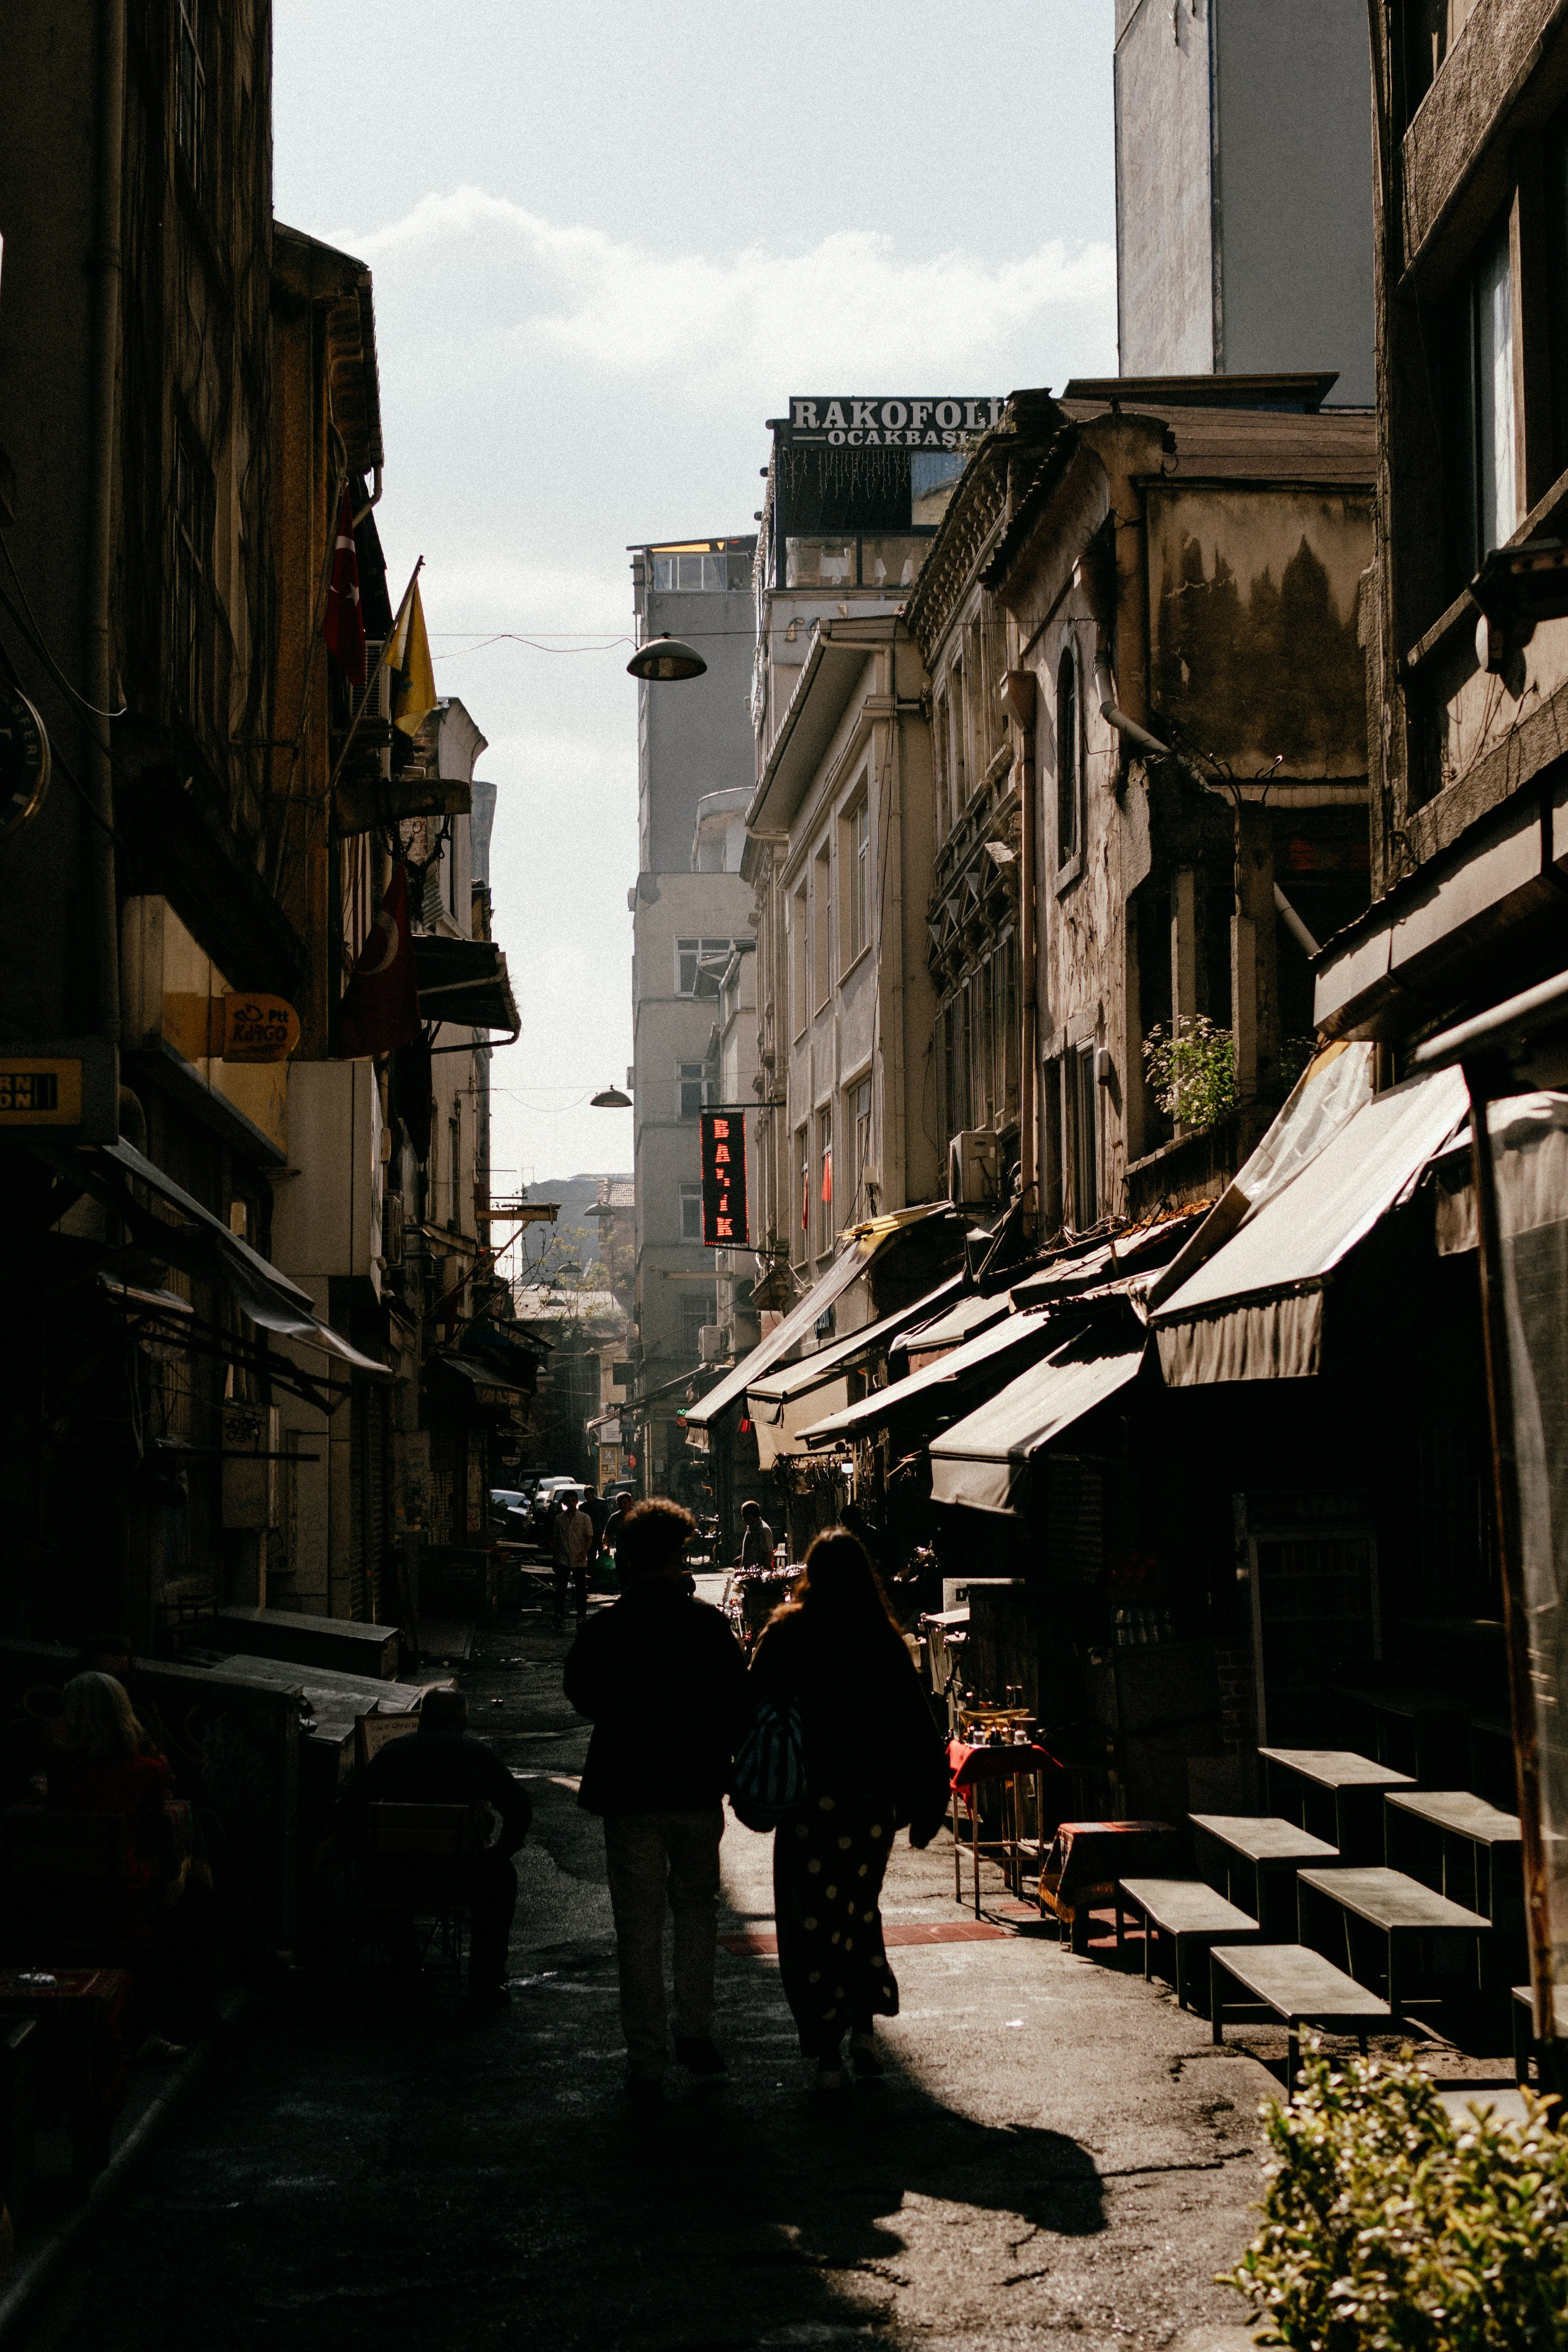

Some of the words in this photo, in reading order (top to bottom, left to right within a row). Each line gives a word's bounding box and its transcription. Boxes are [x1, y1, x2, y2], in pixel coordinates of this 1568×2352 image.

[793, 396, 1001, 429] RAKOFOLİ
[827, 430, 968, 449] OCAKBAŞI
[268, 1009, 288, 1023] Ptt
